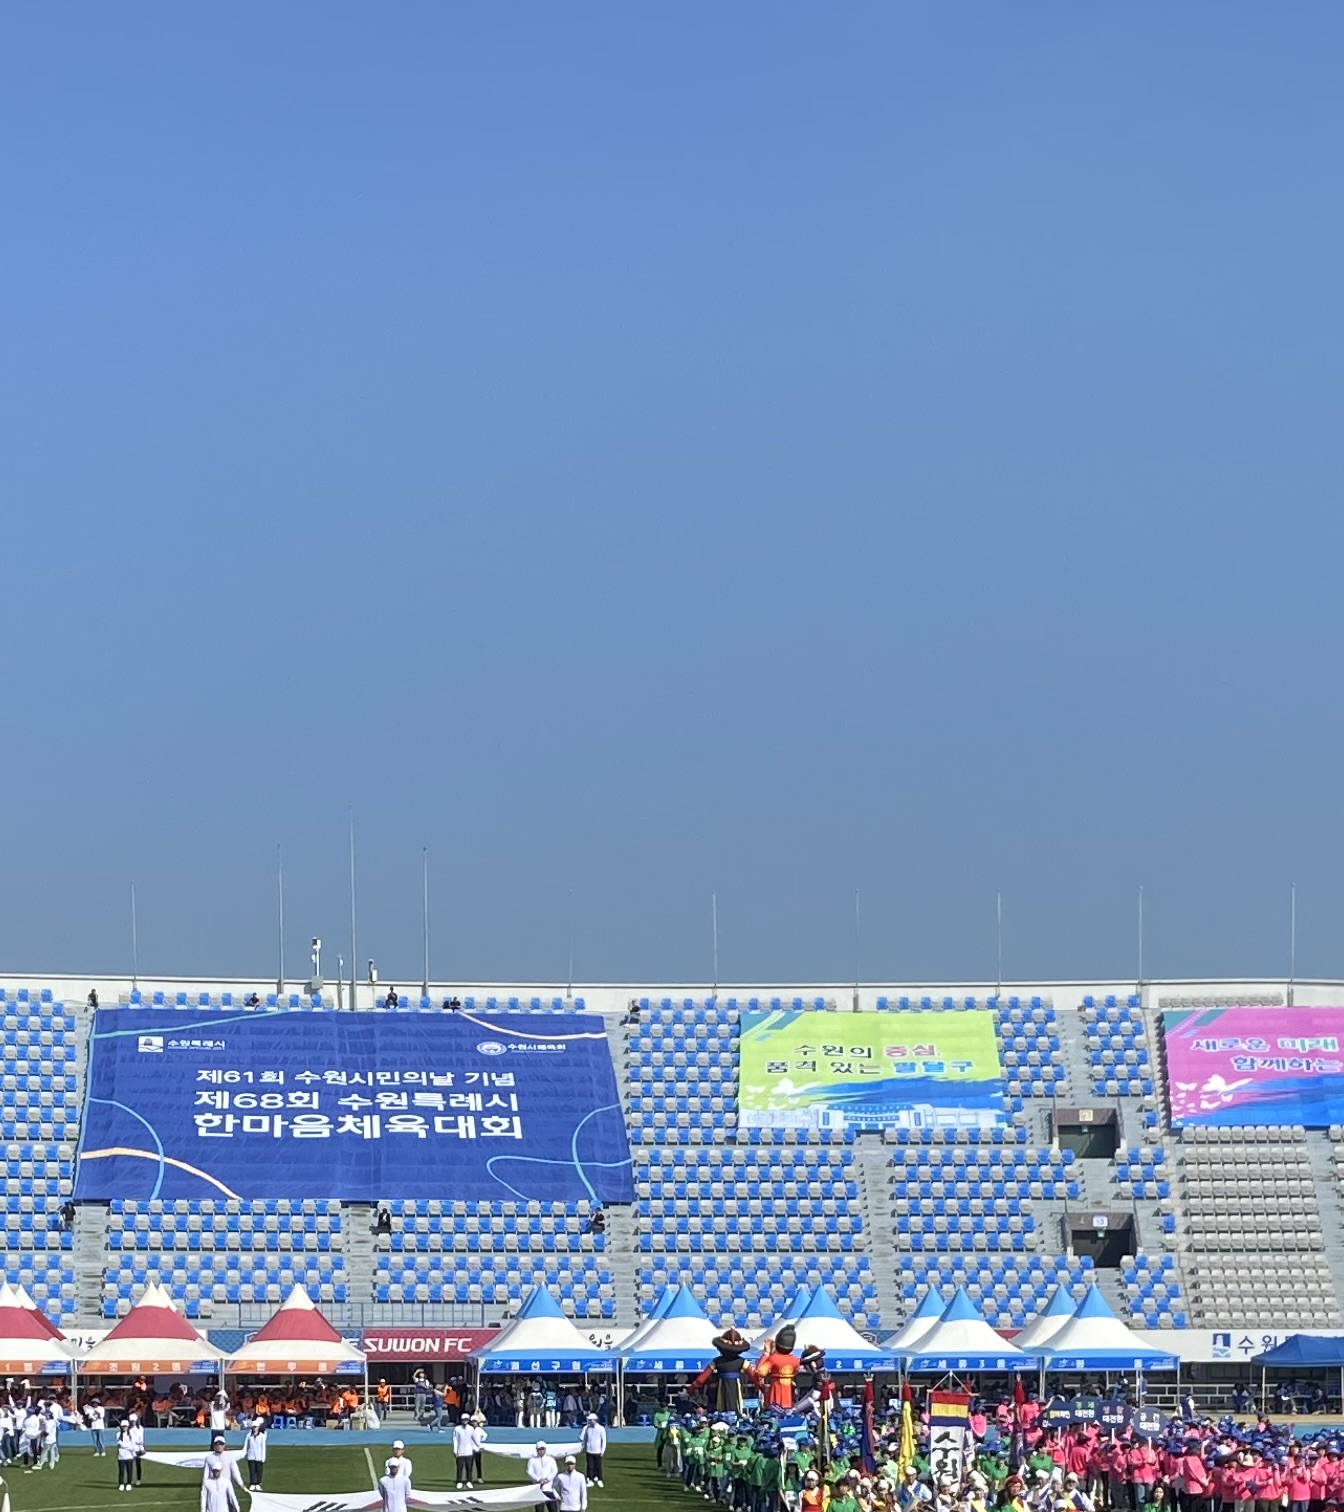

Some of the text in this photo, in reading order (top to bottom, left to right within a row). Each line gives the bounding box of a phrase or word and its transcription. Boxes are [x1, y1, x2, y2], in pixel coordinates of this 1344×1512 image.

[793, 1044, 873, 1059] 수원의
[1191, 1036, 1339, 1053] 새로운 미래
[829, 1060, 883, 1075] 있는
[891, 1060, 975, 1074] 팔달구
[1231, 1056, 1344, 1073] 함께하는
[195, 1069, 515, 1087] 제61회 수원시민의날 기념
[193, 1089, 519, 1112] 제68회 수원특례시
[193, 1112, 523, 1140] 한마음체육대회
[364, 1337, 443, 1353] SUWON
[445, 1337, 473, 1353] FC
[1237, 1334, 1294, 1356] 수원
